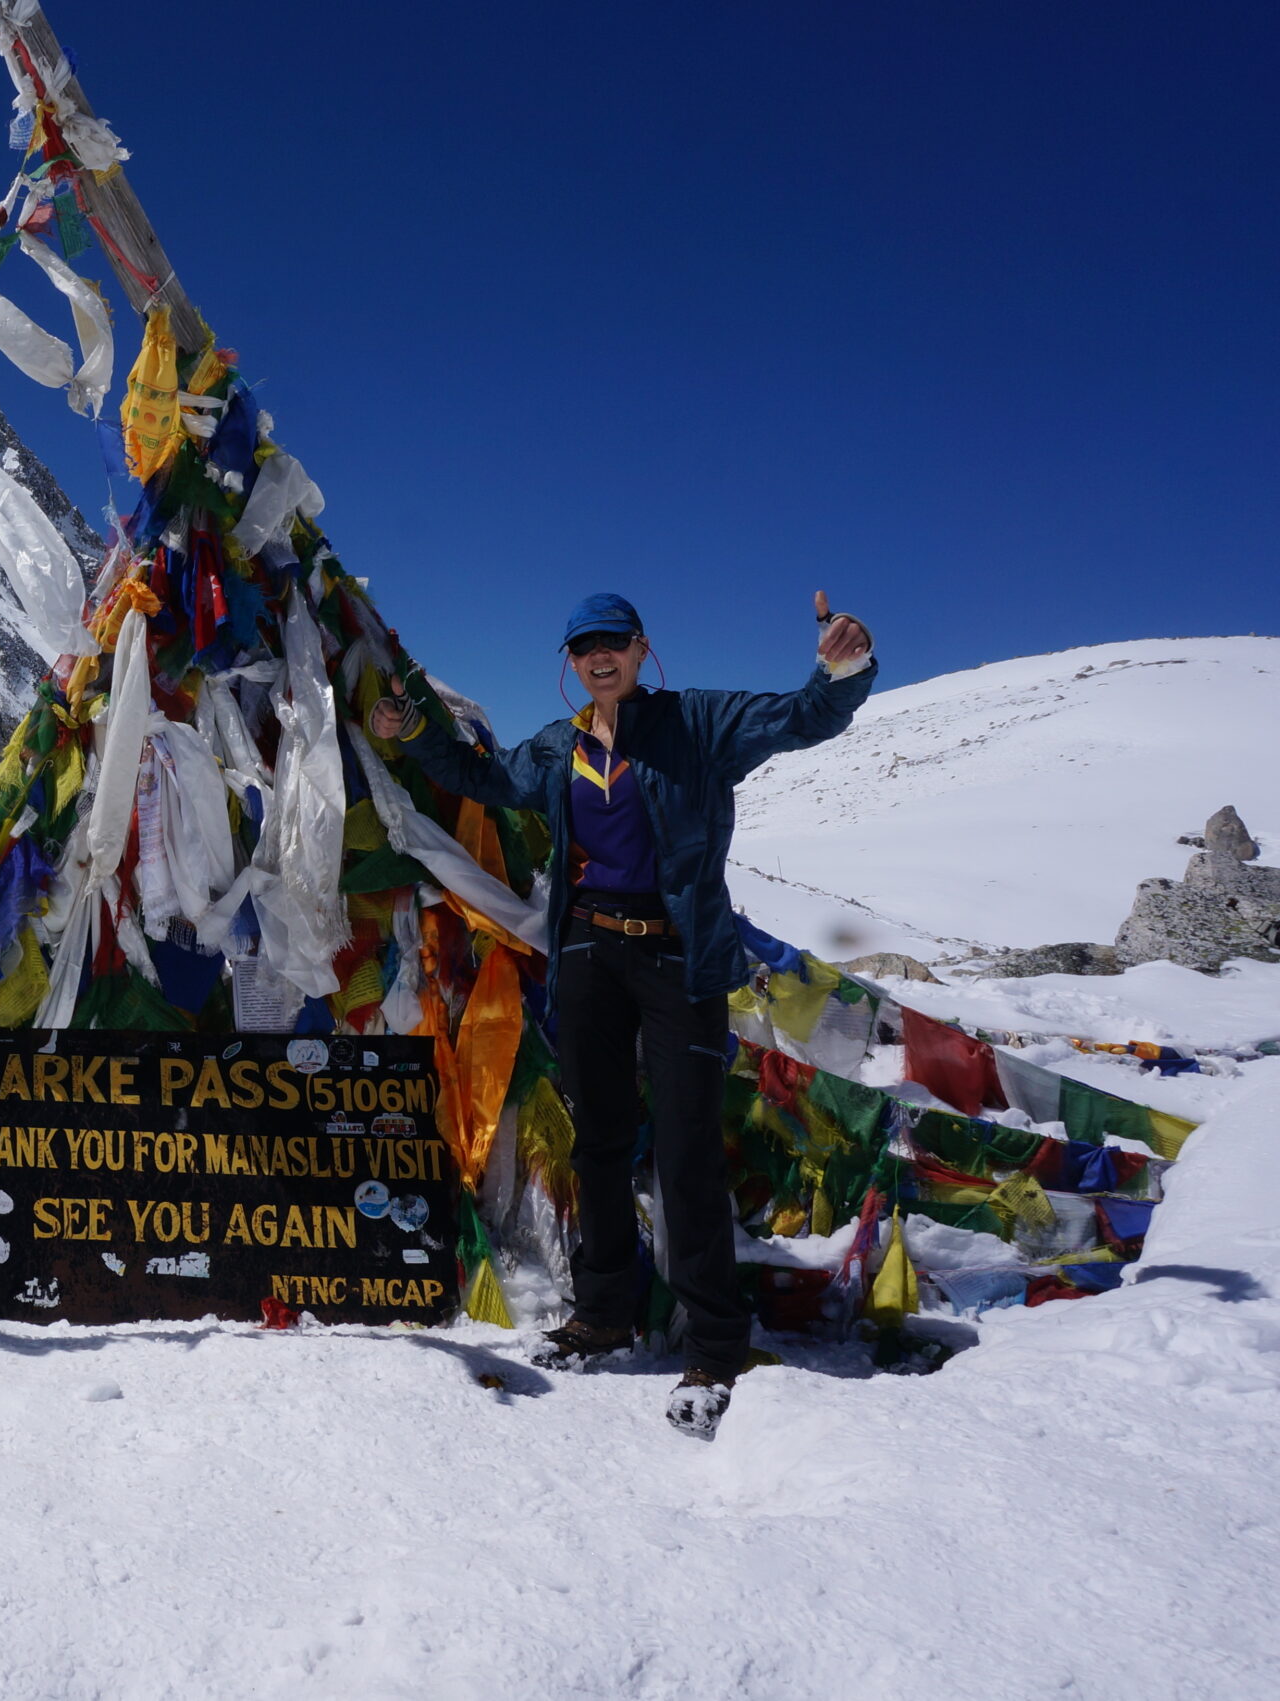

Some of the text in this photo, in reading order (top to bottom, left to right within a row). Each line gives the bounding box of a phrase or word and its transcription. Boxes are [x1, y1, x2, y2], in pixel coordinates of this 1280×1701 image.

[159, 1055, 301, 1110] PASS
[305, 1071, 437, 1114] (5106M)
[63, 1128, 126, 1172] YOU
[132, 1130, 200, 1174] FOR
[202, 1133, 357, 1179] MANASLU
[362, 1137, 445, 1182] VISIT
[32, 1197, 114, 1241] SEE
[126, 1199, 210, 1244] YOU
[223, 1203, 358, 1249] AGAIN
